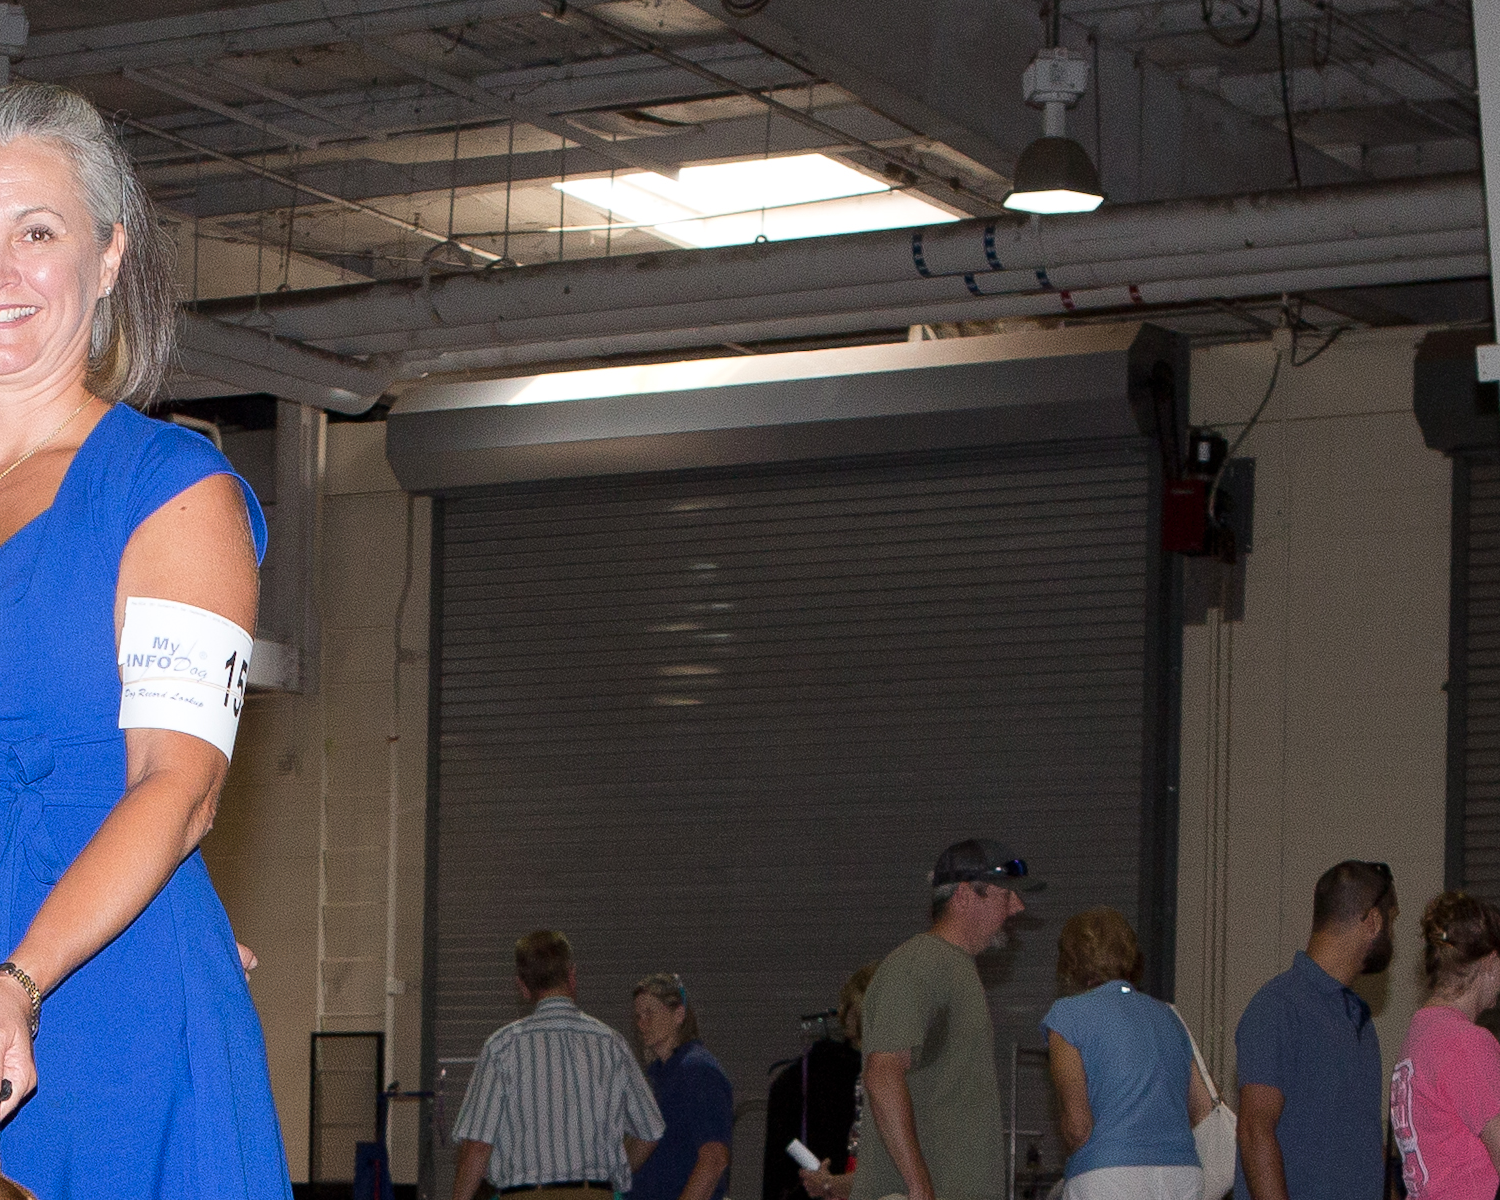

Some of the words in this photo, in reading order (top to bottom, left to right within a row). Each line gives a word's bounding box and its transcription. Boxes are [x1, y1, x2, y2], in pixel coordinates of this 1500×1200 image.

[152, 636, 180, 656] My
[138, 688, 167, 699] Record
[170, 693, 204, 708] Lookup
